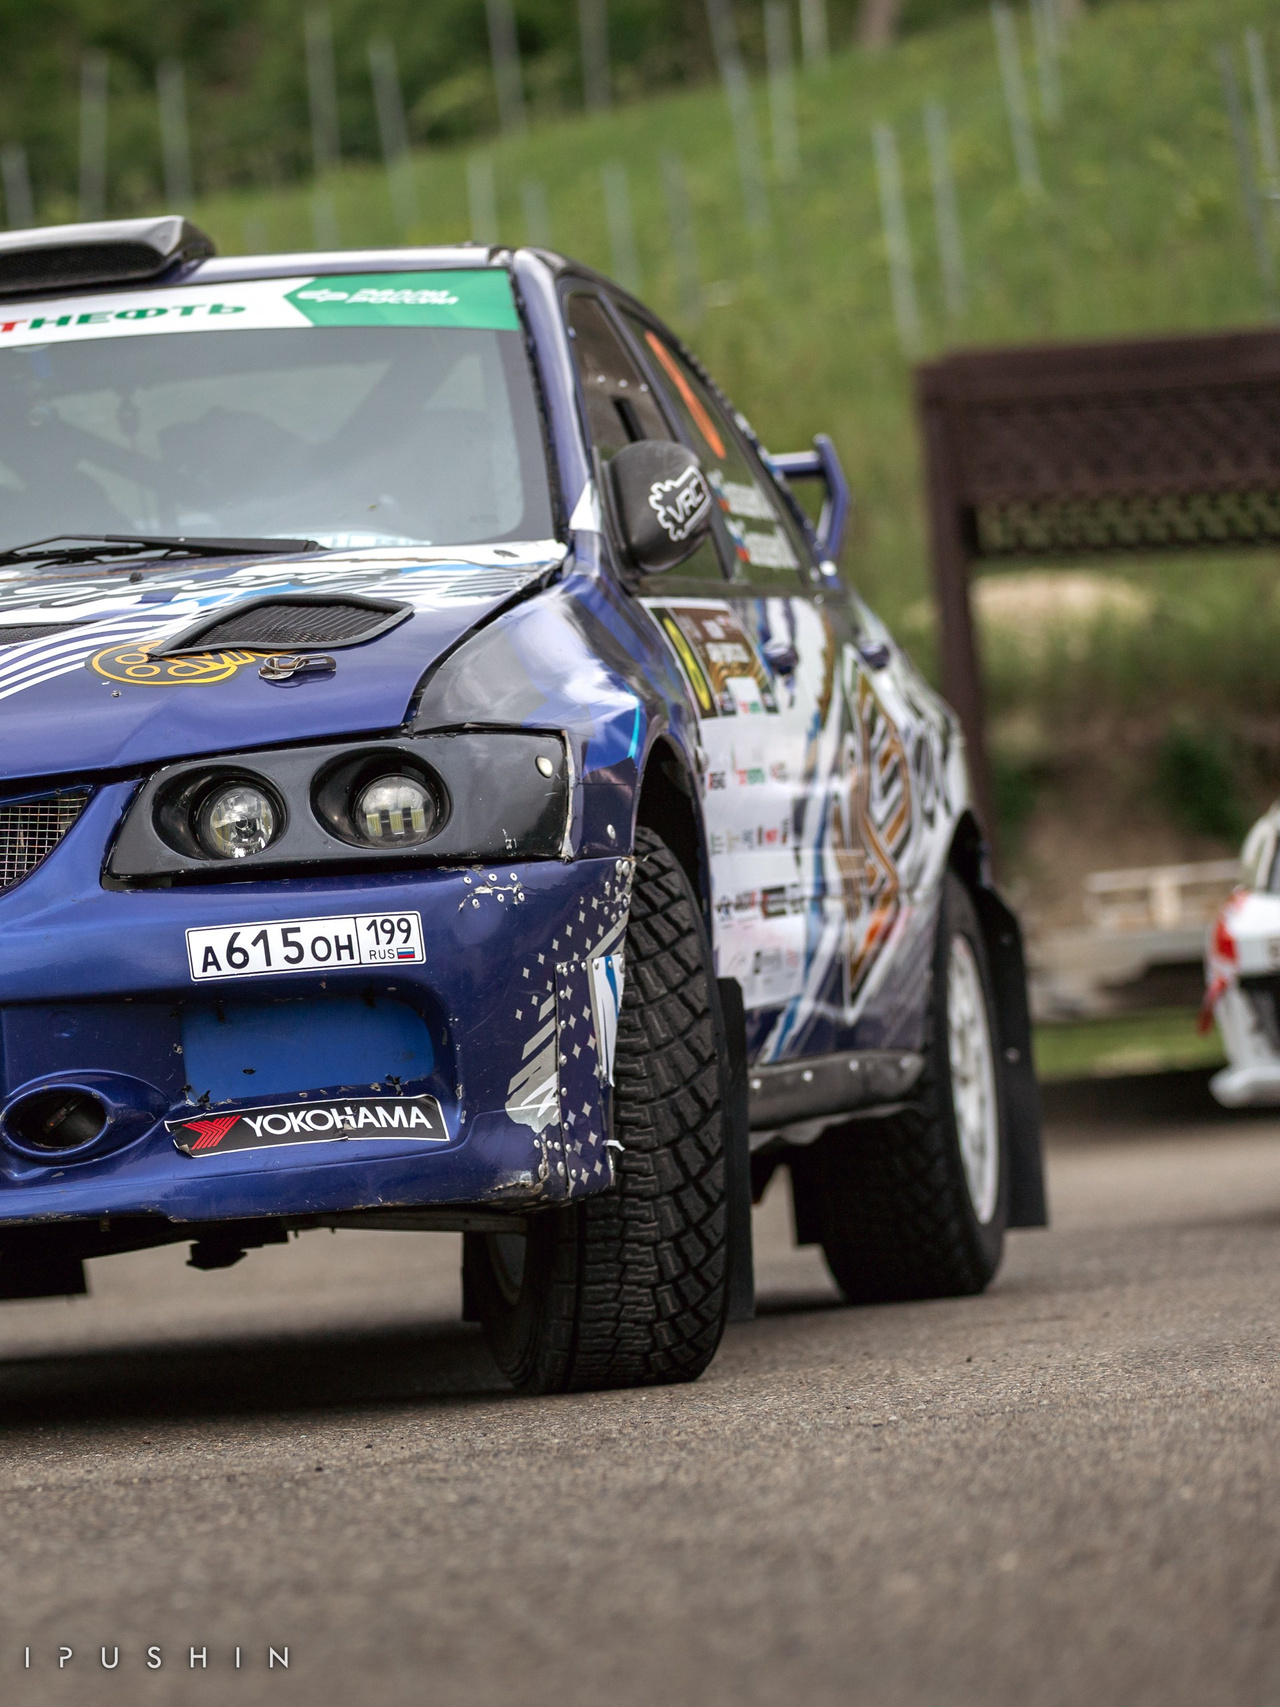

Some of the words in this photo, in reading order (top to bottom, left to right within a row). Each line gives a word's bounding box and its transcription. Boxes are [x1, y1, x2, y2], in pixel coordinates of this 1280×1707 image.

[366, 917, 412, 946] 199
[369, 948, 395, 961] RUS
[242, 1106, 433, 1138] YOKOHAMA
